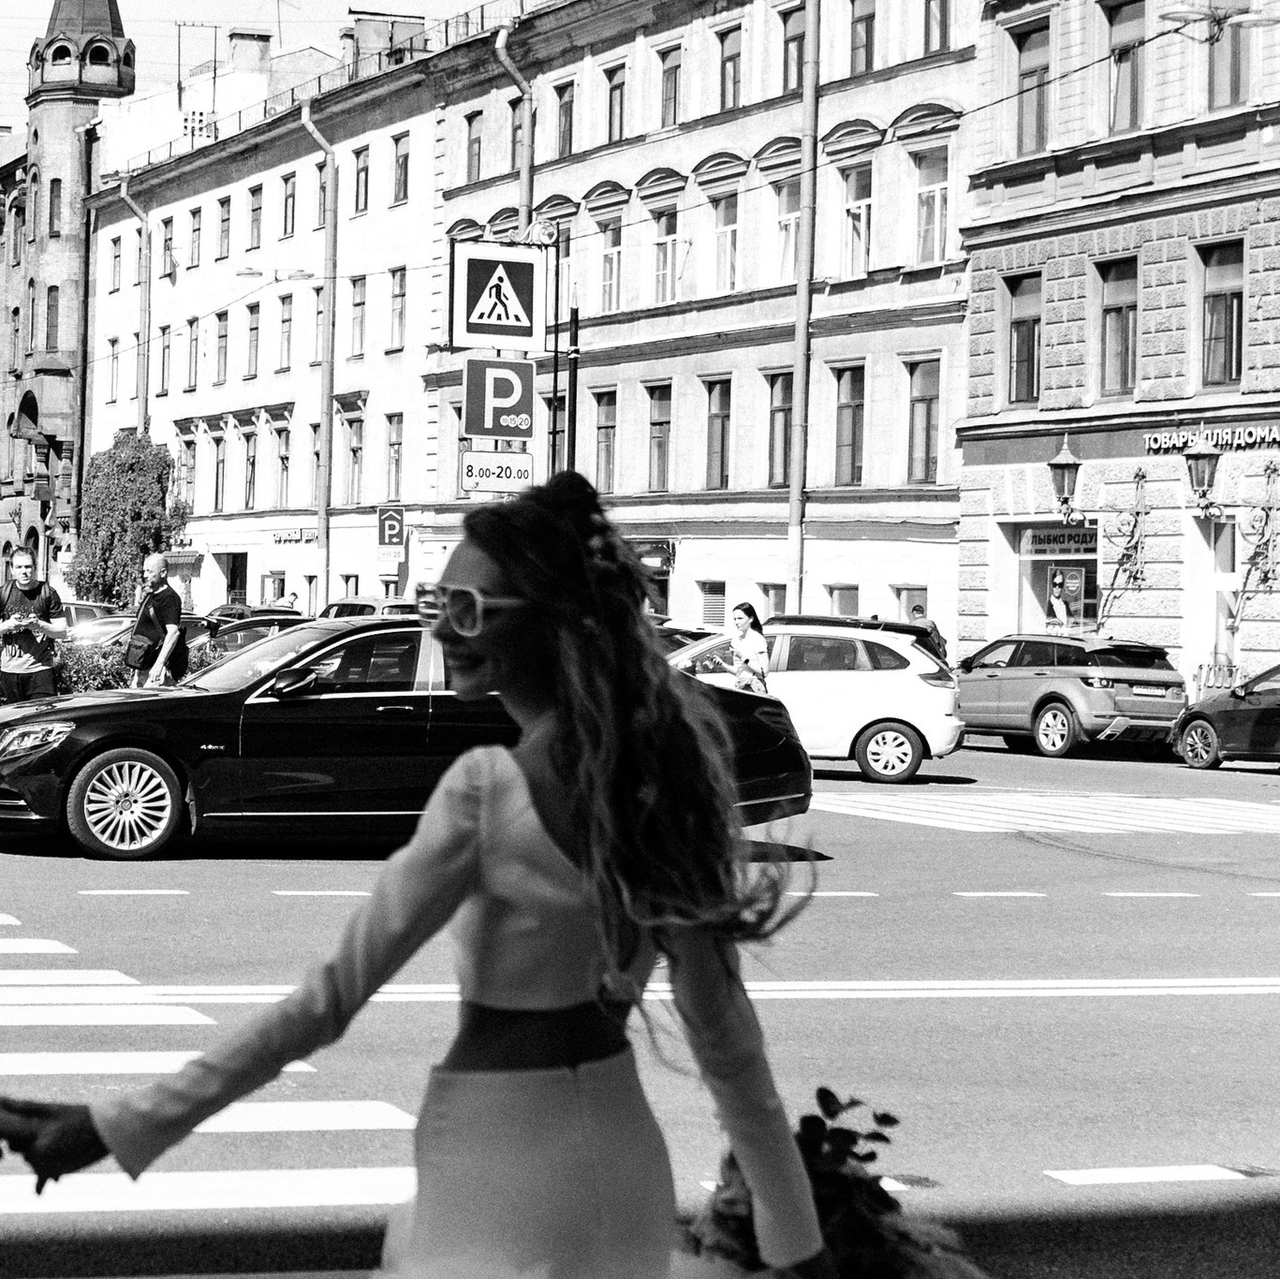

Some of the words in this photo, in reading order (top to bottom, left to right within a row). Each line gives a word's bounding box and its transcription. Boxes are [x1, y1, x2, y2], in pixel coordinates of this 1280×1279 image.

[484, 367, 522, 429] P
[518, 416, 530, 427] 20
[1143, 430, 1199, 449] ТОВАРЫ
[1233, 425, 1280, 447] ДОМА
[465, 464, 529, 480] 8.00-20.00
[384, 520, 400, 543] P
